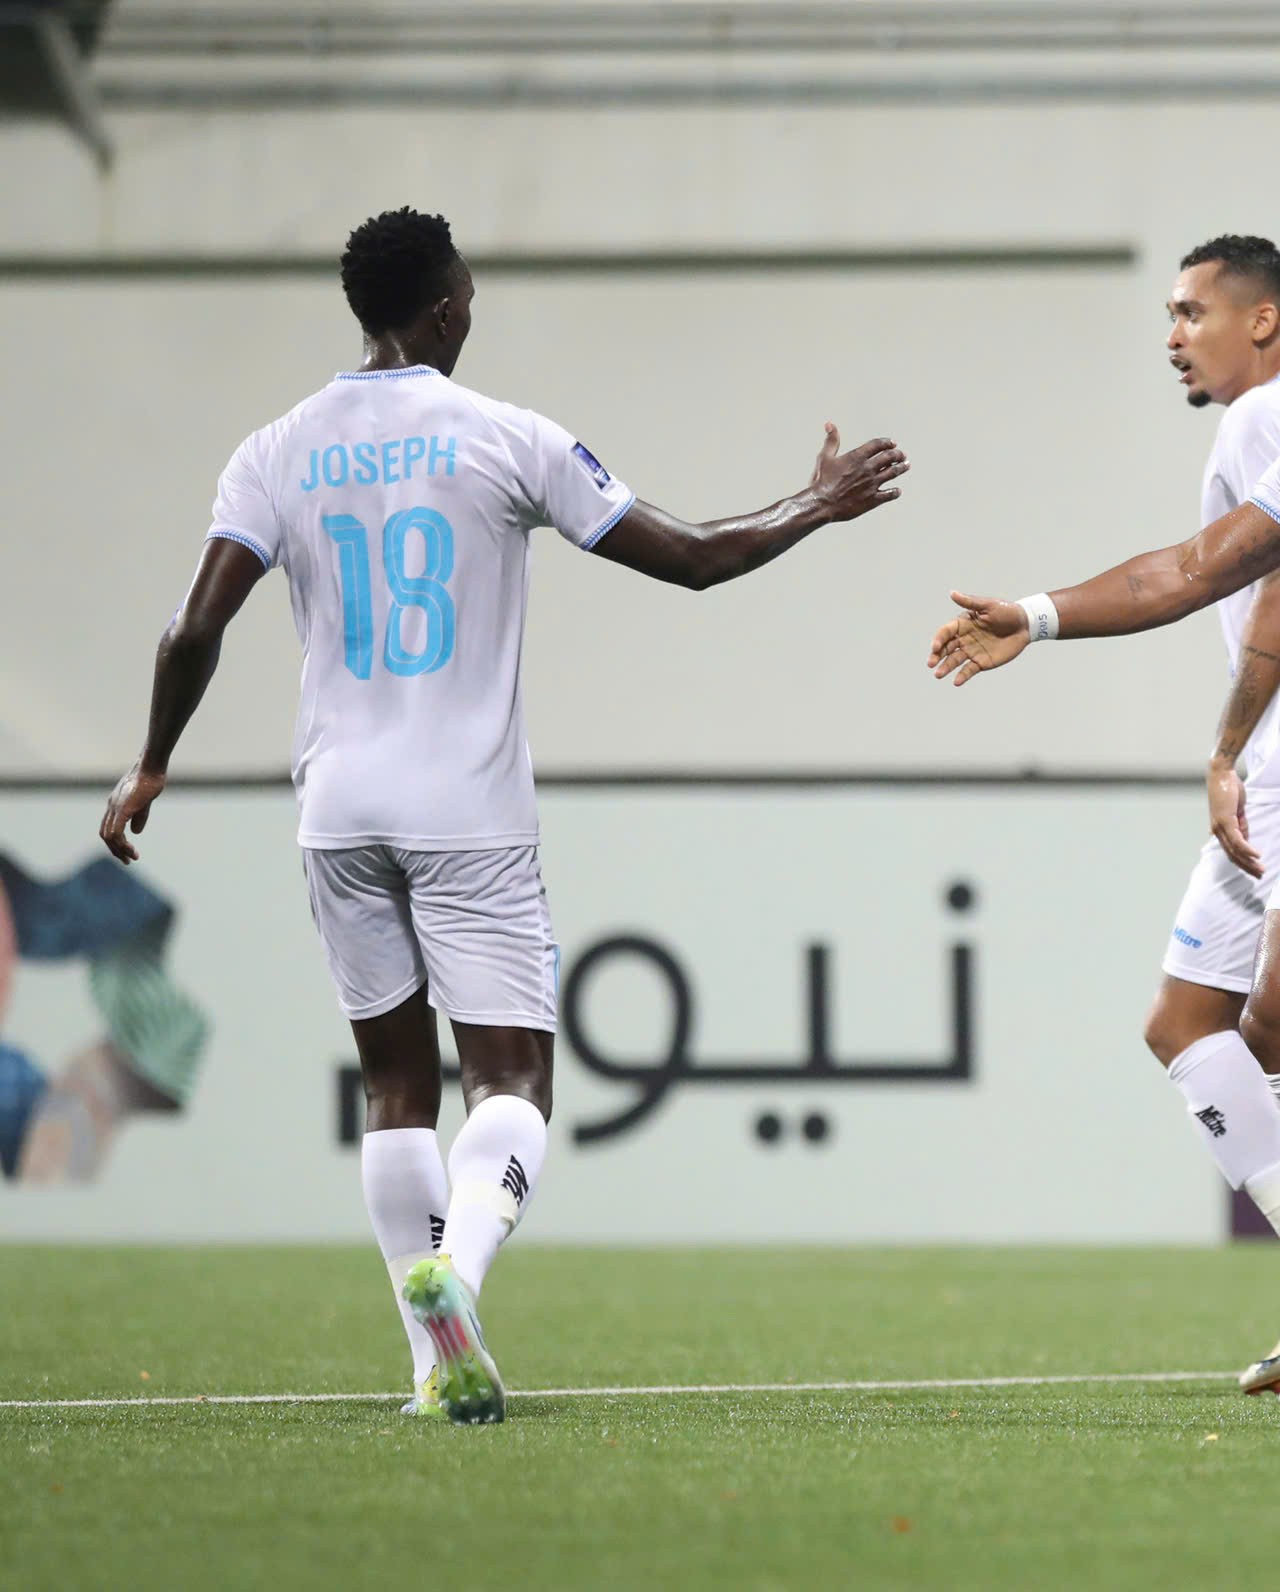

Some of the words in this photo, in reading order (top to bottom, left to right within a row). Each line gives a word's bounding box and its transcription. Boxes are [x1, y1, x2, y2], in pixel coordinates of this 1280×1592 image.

[301, 435, 457, 492] JOSEPH
[321, 506, 456, 680] 18
[1195, 1105, 1226, 1138] Mitre
